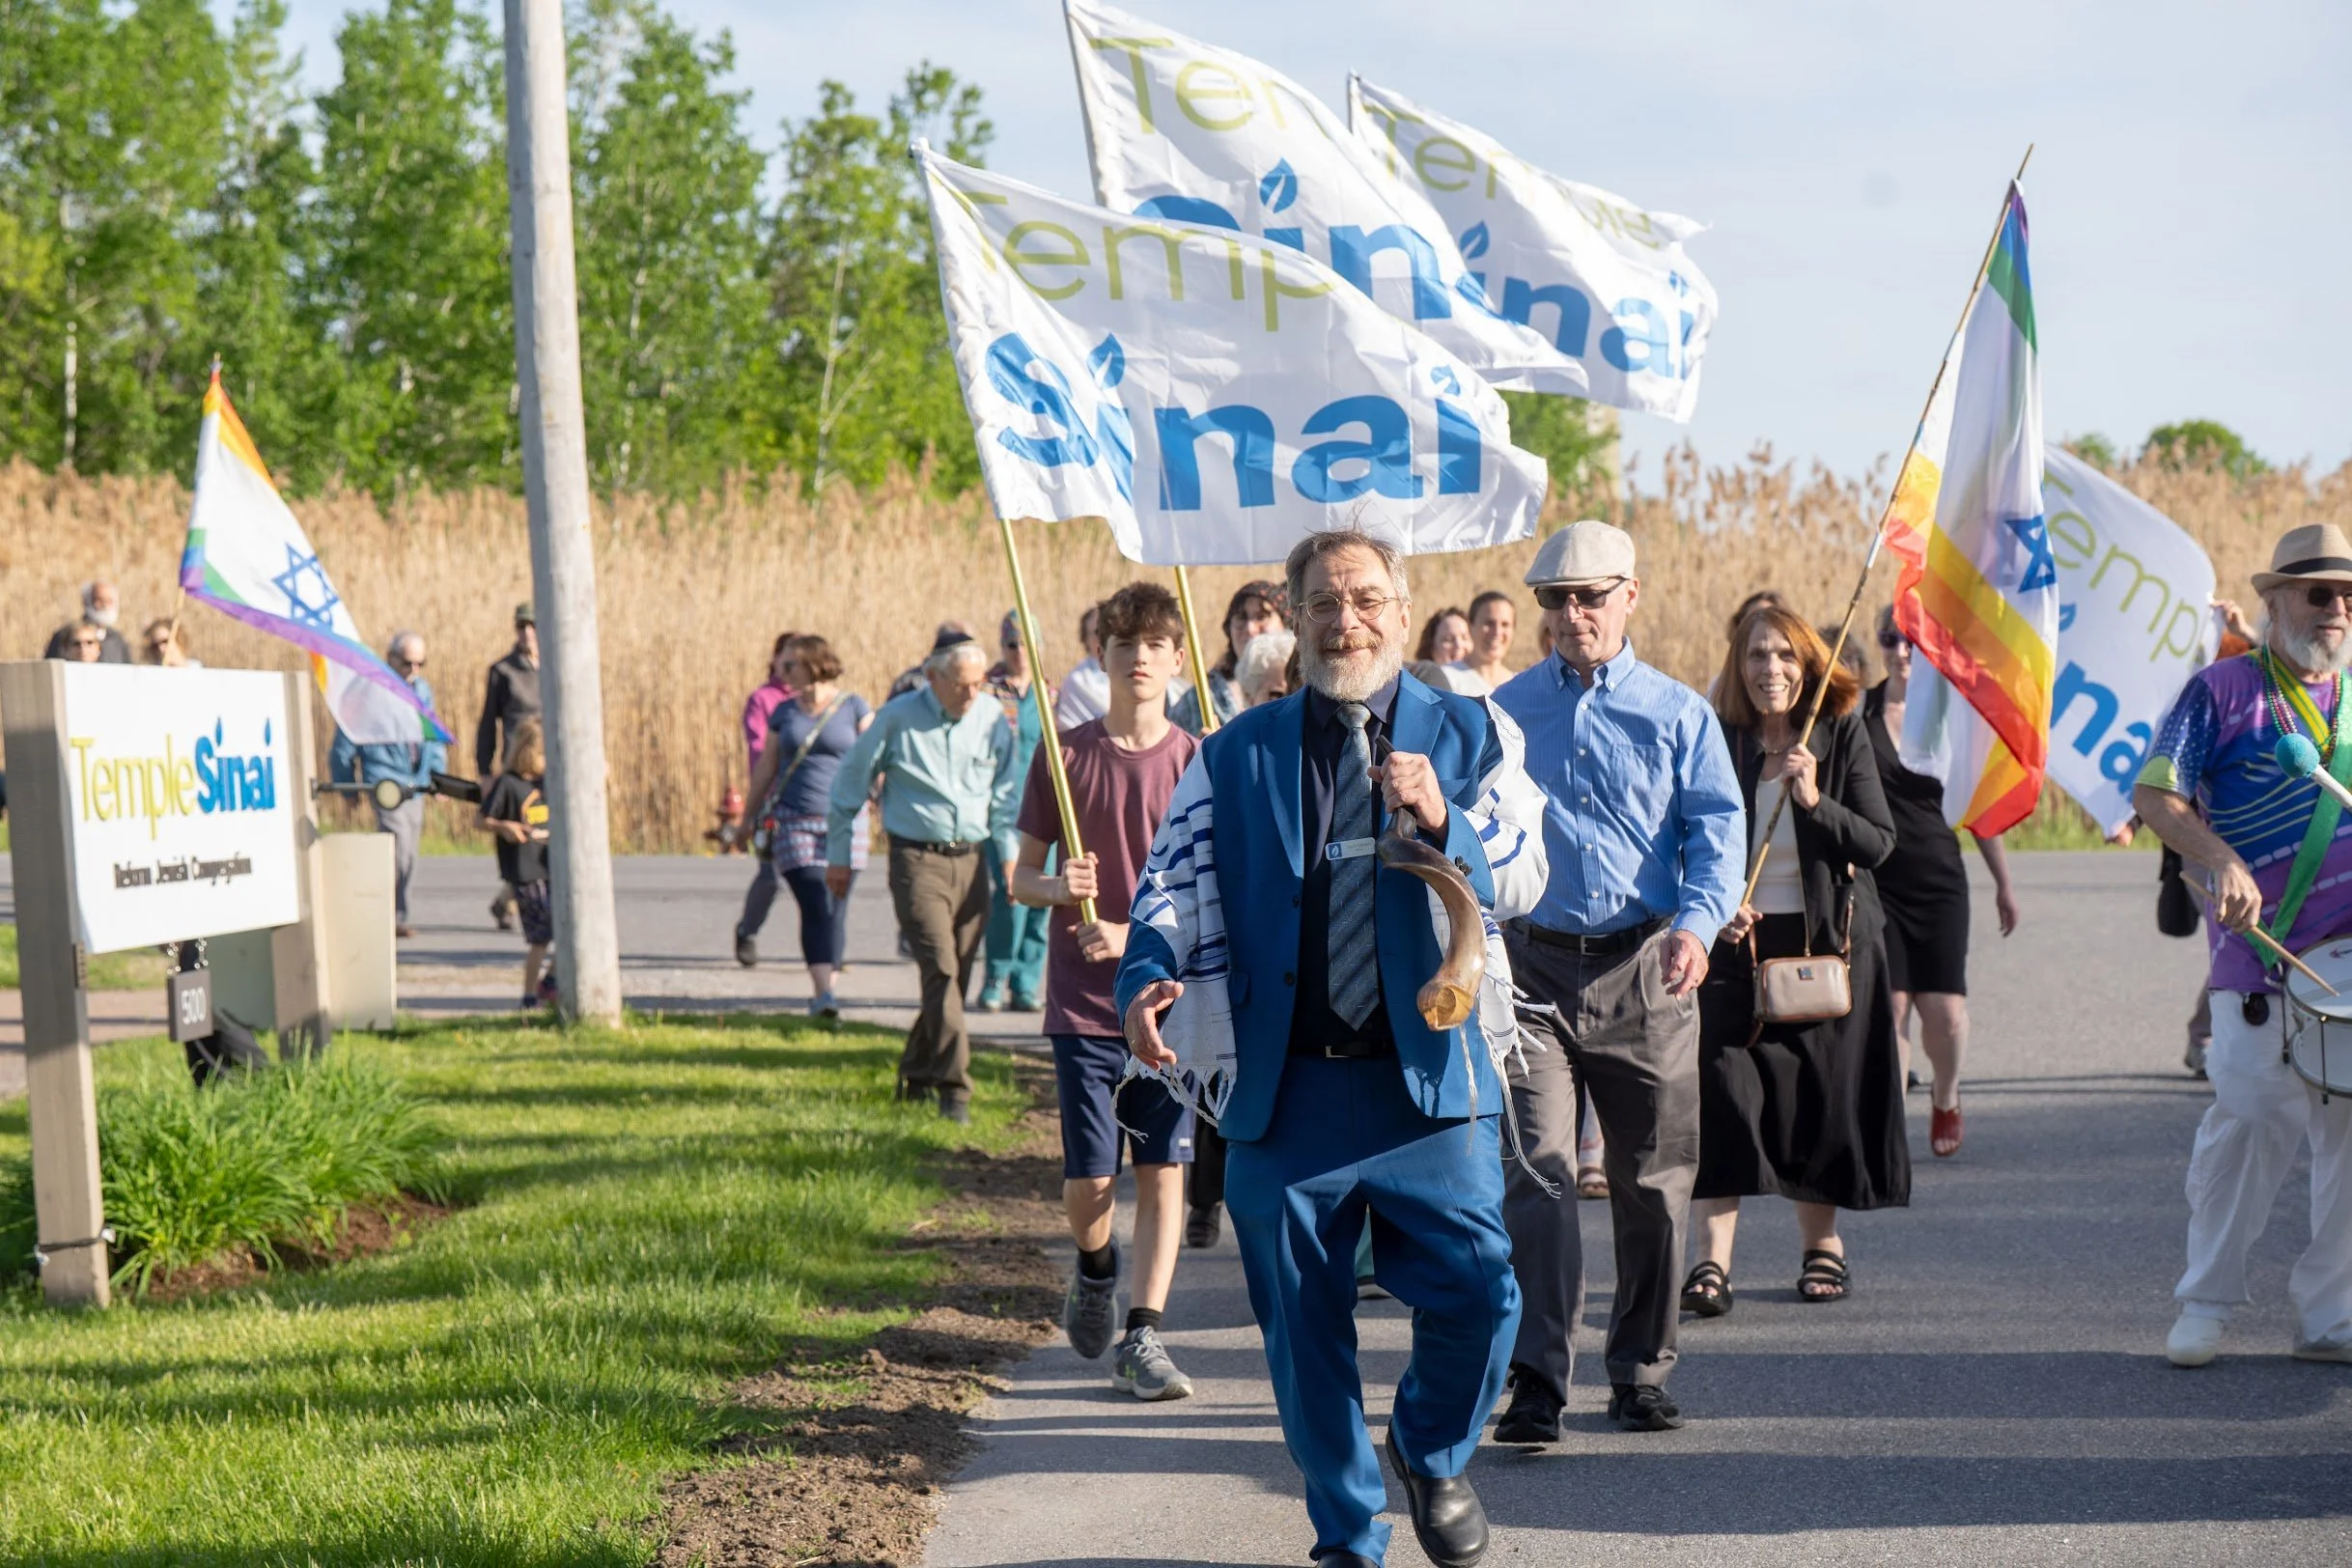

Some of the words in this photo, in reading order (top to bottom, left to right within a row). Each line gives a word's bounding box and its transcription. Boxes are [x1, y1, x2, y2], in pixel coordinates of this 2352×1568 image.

[930, 174, 1334, 331] Temp
[985, 332, 1480, 510] Sinai
[181, 986, 207, 1025] 500
